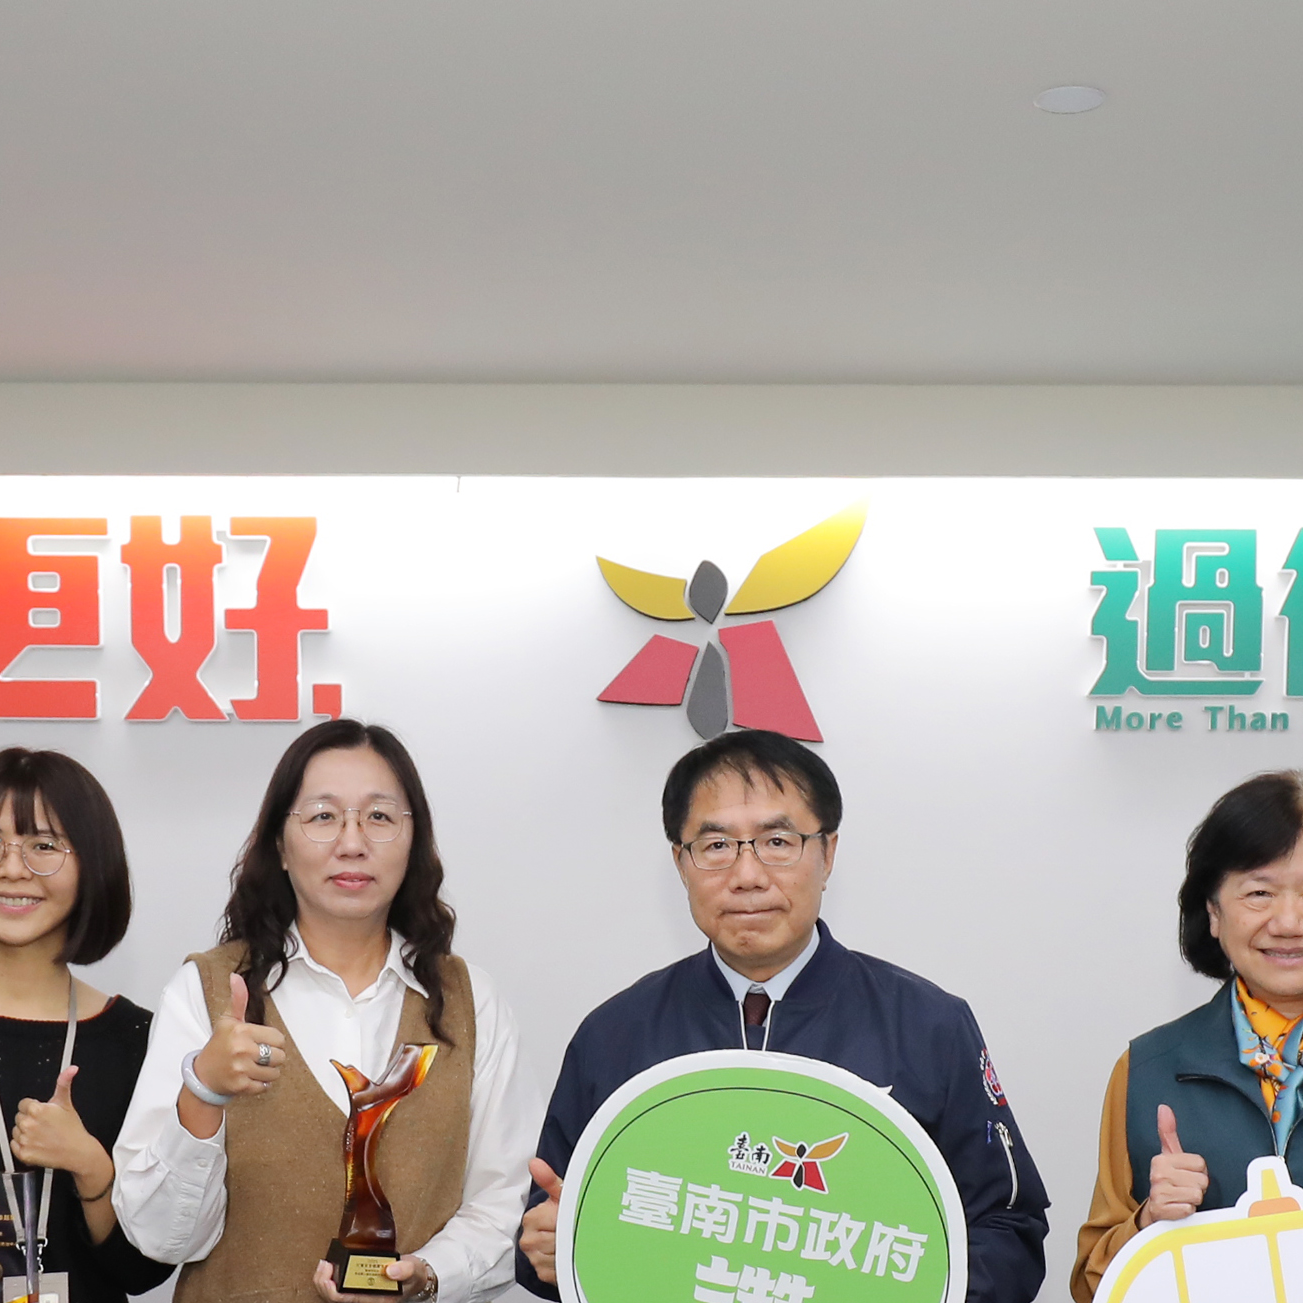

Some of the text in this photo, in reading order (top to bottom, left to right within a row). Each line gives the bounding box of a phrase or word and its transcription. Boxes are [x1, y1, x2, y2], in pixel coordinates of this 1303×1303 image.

[1095, 706, 1162, 730] More
[1205, 705, 1289, 730] Than
[730, 1160, 766, 1175] TAINAN
[618, 1167, 929, 1282] 臺南市政府
